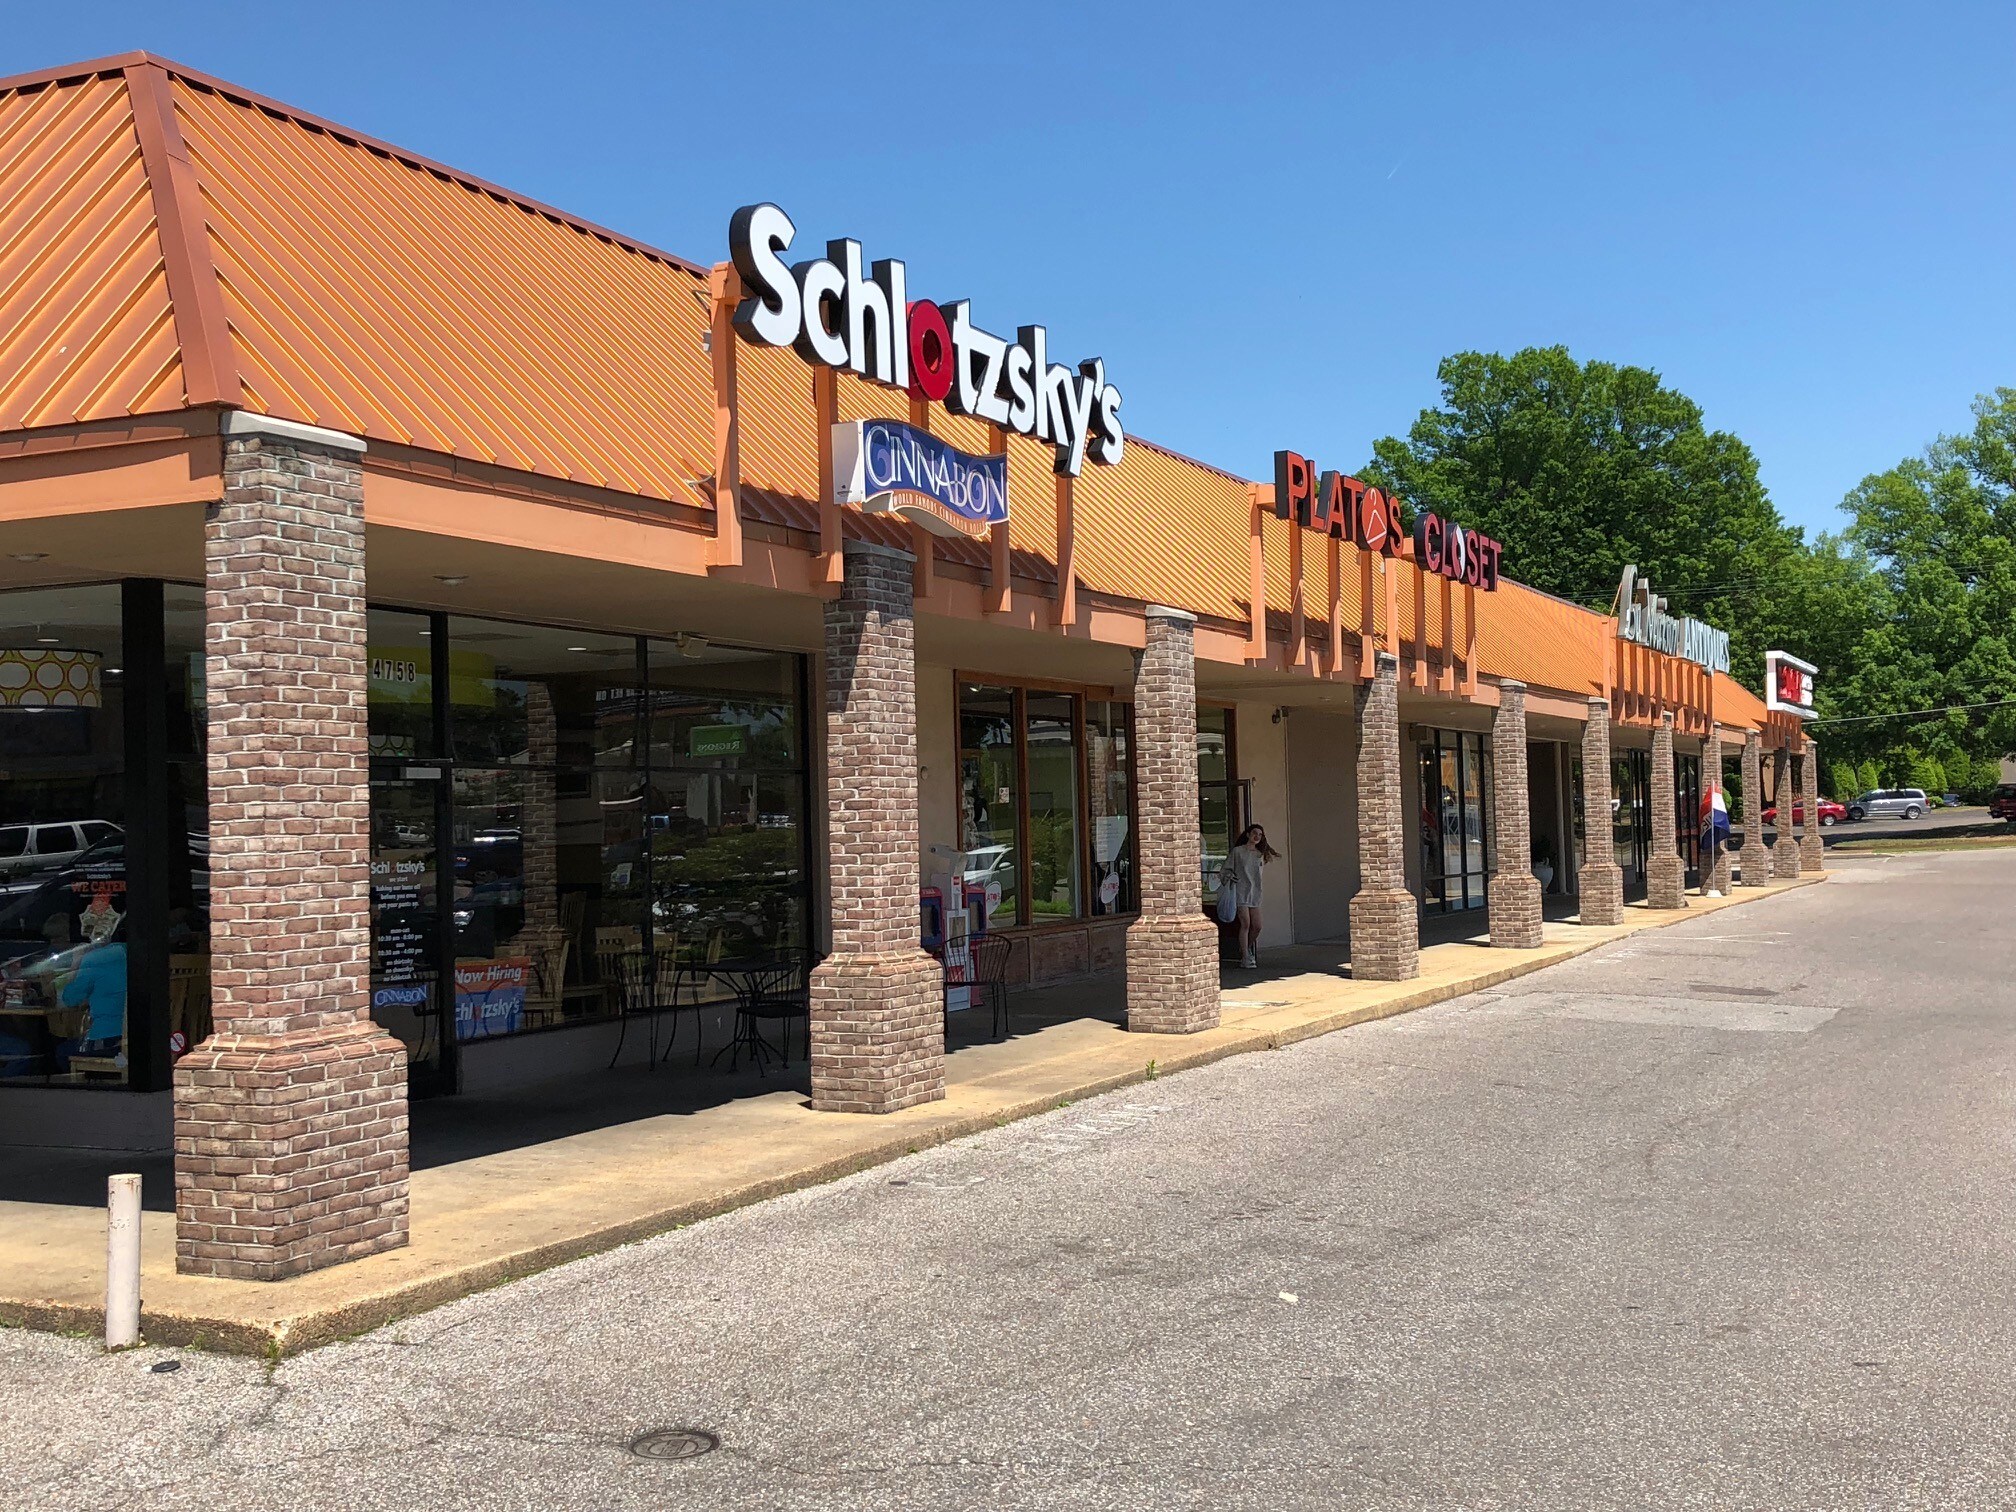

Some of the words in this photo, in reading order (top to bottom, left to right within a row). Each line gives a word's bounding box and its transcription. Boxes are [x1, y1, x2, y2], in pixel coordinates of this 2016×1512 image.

[729, 202, 1125, 478] Schlotzsky's
[865, 424, 1005, 516] CINNABON
[893, 493, 913, 506] WORLD
[915, 495, 937, 514] FAMOUS
[939, 506, 968, 531] CINNAMON
[969, 520, 986, 534] ROLLS
[1415, 512, 1503, 592] CLOSET
[373, 659, 416, 682] 4758
[455, 968, 484, 984] Now
[487, 963, 522, 982] Hiring
